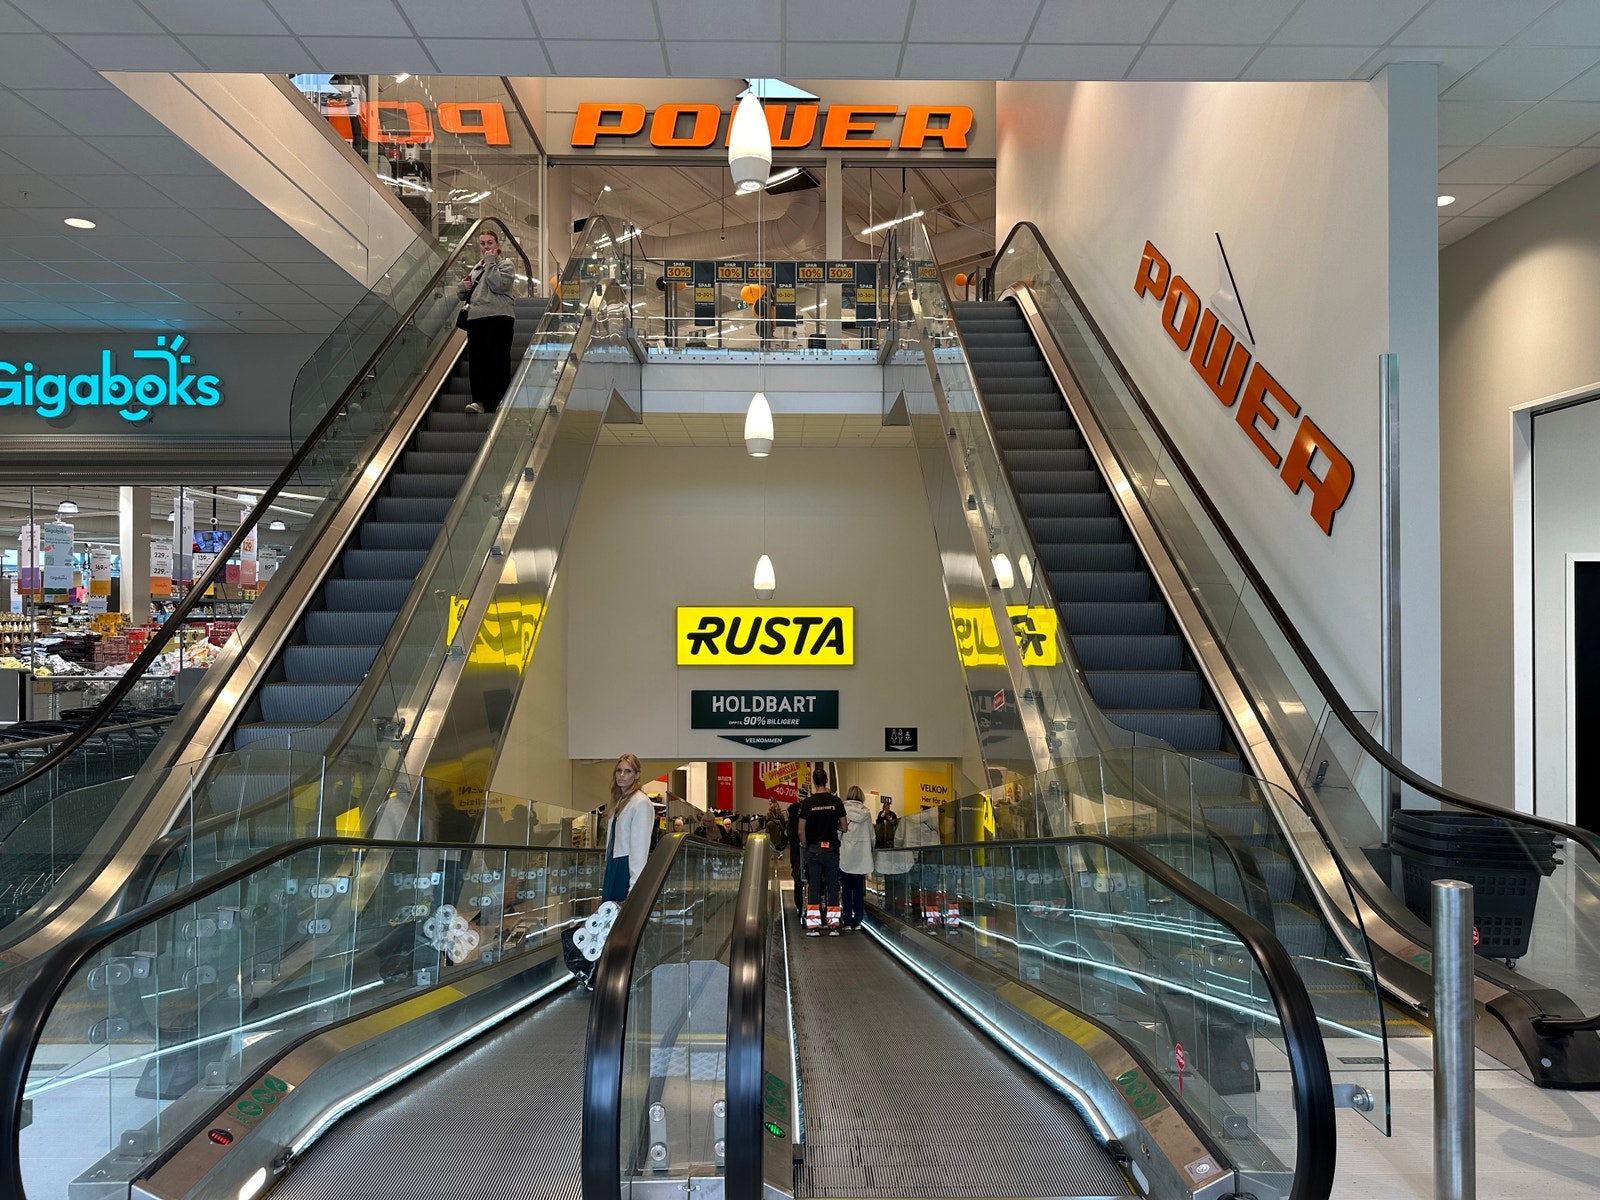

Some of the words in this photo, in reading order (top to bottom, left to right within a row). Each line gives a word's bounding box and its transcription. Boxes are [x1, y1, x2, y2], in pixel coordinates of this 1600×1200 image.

[571, 102, 973, 150] POWER
[668, 267, 690, 277] 30%
[719, 268, 741, 277] 10%
[800, 269, 821, 278] 10%
[830, 269, 852, 278] 30%
[0, 346, 221, 420] Gigaboks
[1134, 240, 1355, 536] POWER
[686, 616, 844, 655] RUSTA
[712, 696, 816, 713] HOLDBART
[743, 716, 766, 725] 90%
